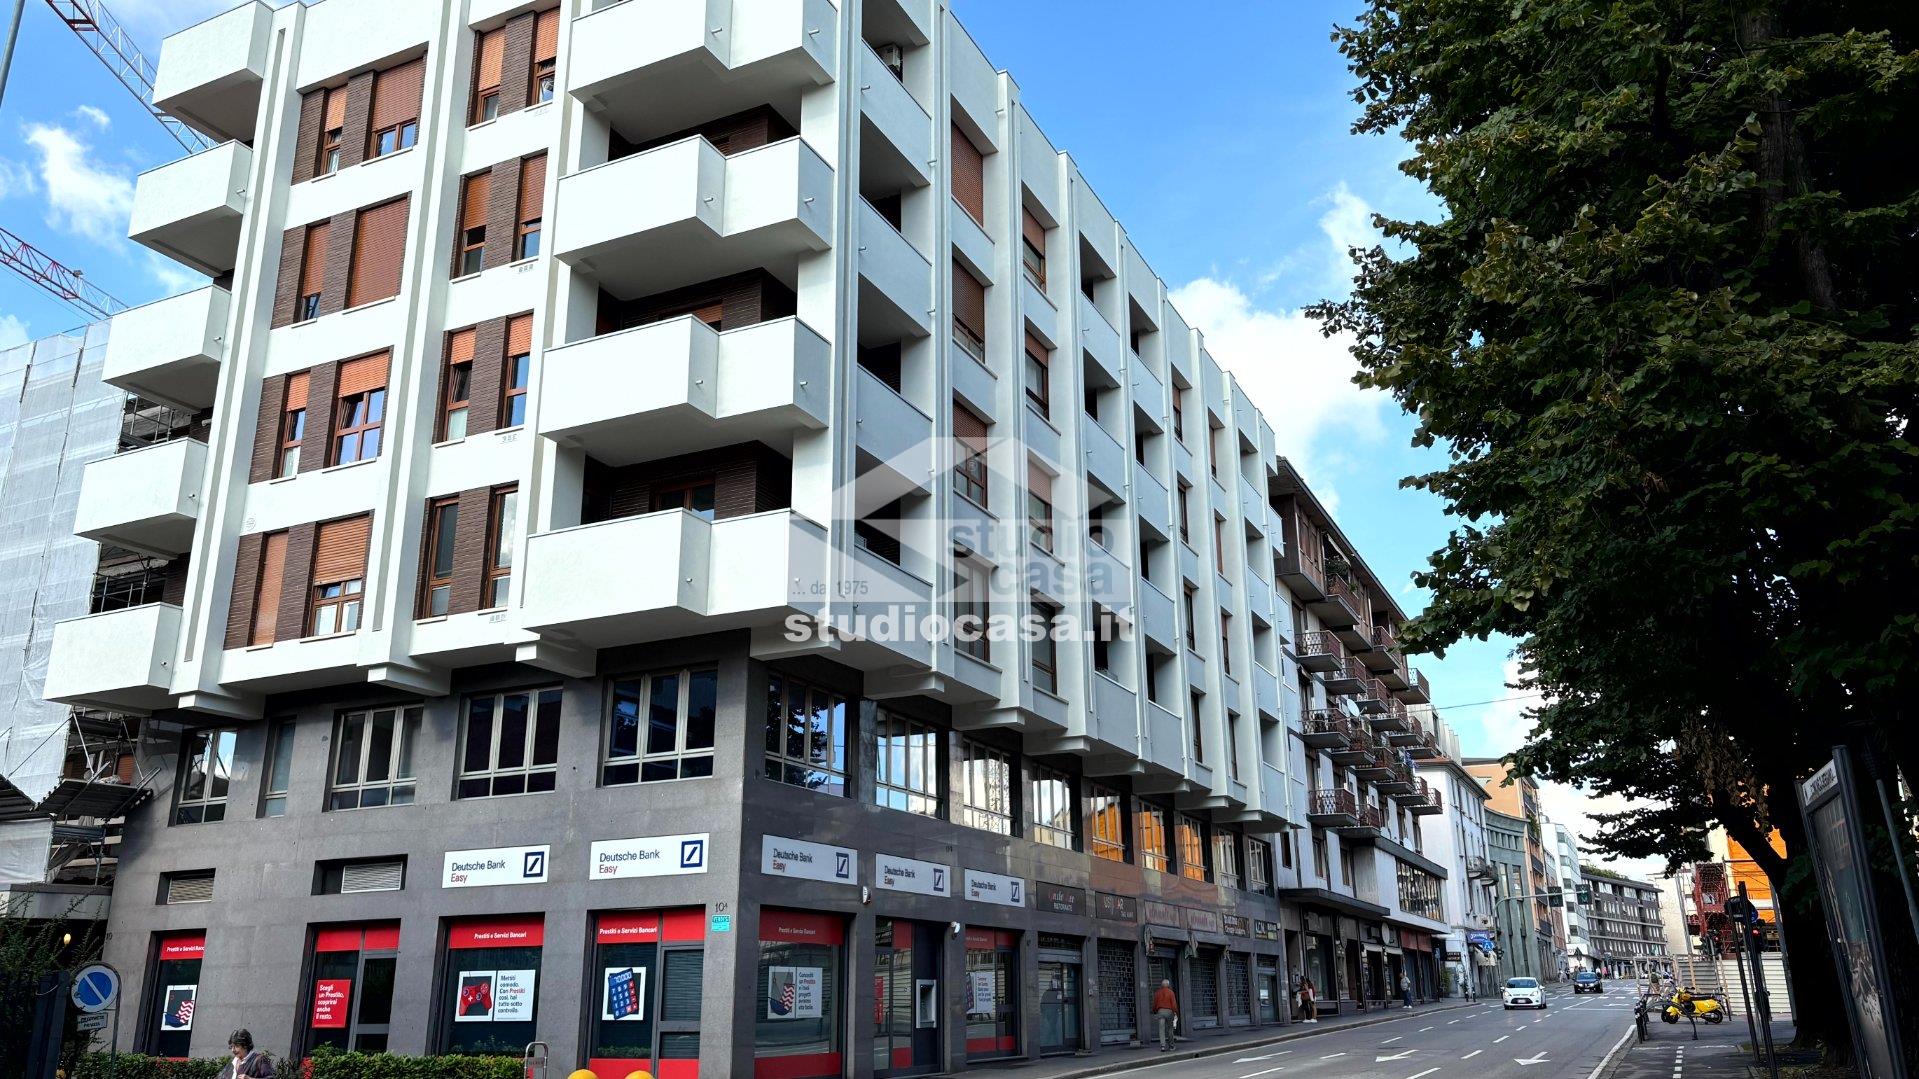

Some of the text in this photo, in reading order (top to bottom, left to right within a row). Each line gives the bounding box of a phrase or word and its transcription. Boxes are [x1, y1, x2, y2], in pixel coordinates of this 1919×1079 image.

[599, 850, 660, 863] Deutsche Bank
[773, 848, 813, 863] Deutsche Bank
[452, 860, 506, 872] Deutsche Bank
[599, 864, 618, 875] Easy
[773, 860, 786, 872] Easy
[451, 873, 468, 883] Easy
[884, 866, 915, 879] Deutsche Bank
[884, 875, 895, 887] Easy
[971, 880, 997, 891] Deutsche Bank
